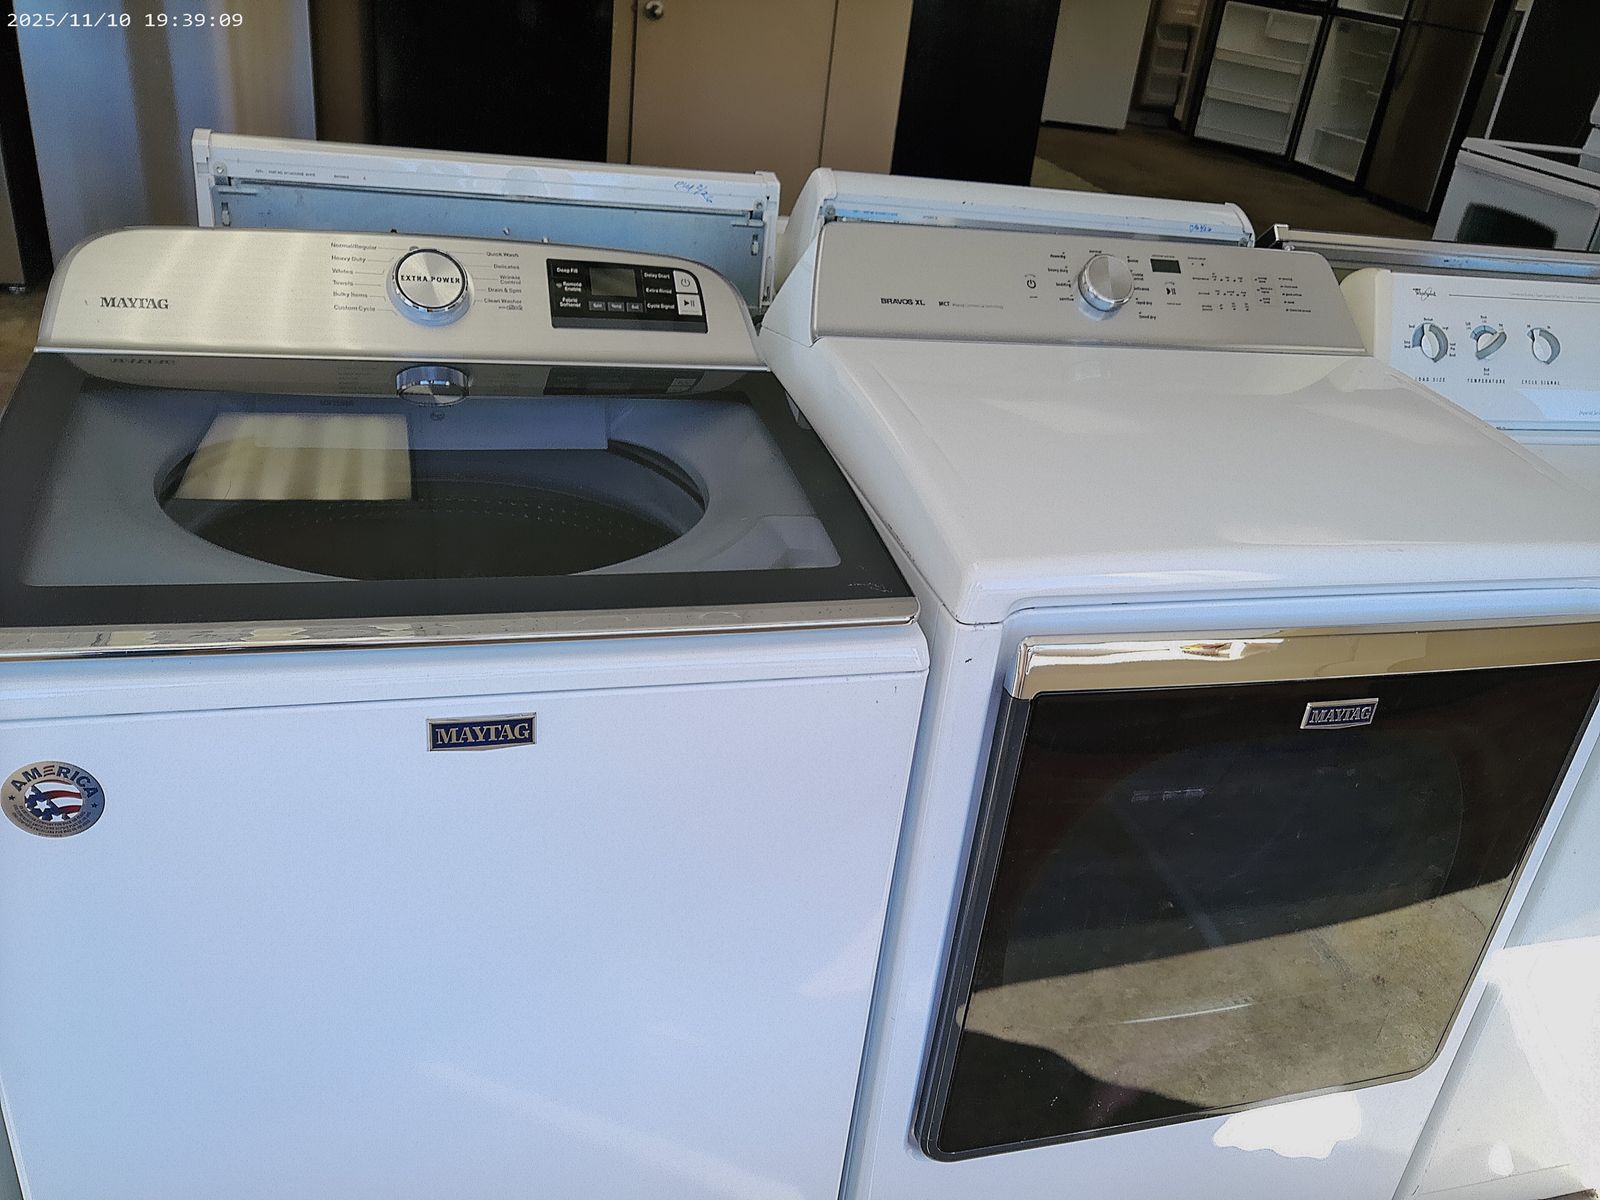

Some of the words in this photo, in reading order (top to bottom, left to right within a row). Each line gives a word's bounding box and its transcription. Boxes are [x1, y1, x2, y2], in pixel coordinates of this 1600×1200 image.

[556, 266, 571, 275] Deep
[643, 272, 658, 280] Delay
[400, 274, 428, 283] EXTRA
[430, 275, 461, 284] POWER
[100, 296, 169, 310] MAYTAG
[880, 297, 914, 305] BRAVOS
[915, 298, 926, 306] XL
[1309, 706, 1372, 723] MAYTAG
[435, 723, 530, 745] MAYTAG
[11, 765, 99, 799] AMERICA
